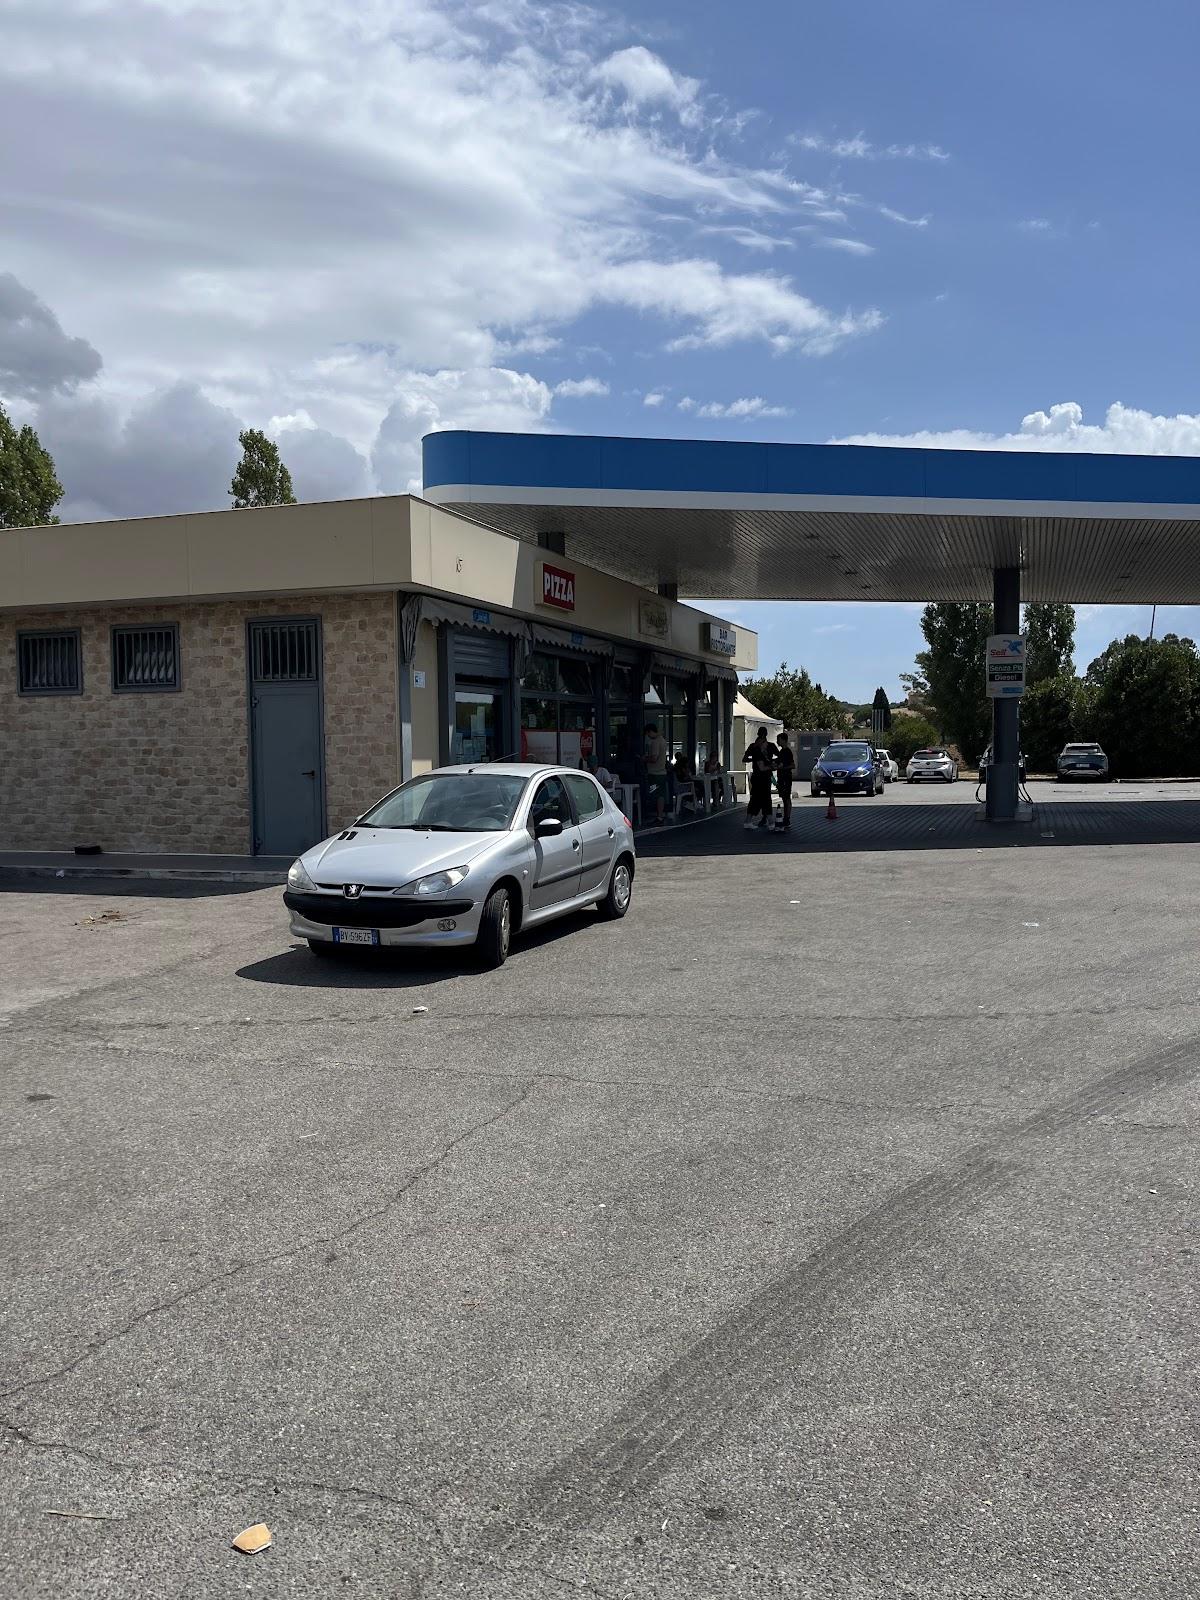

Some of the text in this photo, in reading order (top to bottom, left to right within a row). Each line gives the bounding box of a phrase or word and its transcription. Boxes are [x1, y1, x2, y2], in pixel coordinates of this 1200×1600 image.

[544, 571, 574, 603] PIZZA
[719, 628, 728, 640] BAR
[990, 648, 1006, 656] Self
[989, 664, 1011, 672] Senza
[994, 673, 1017, 681] Diesel
